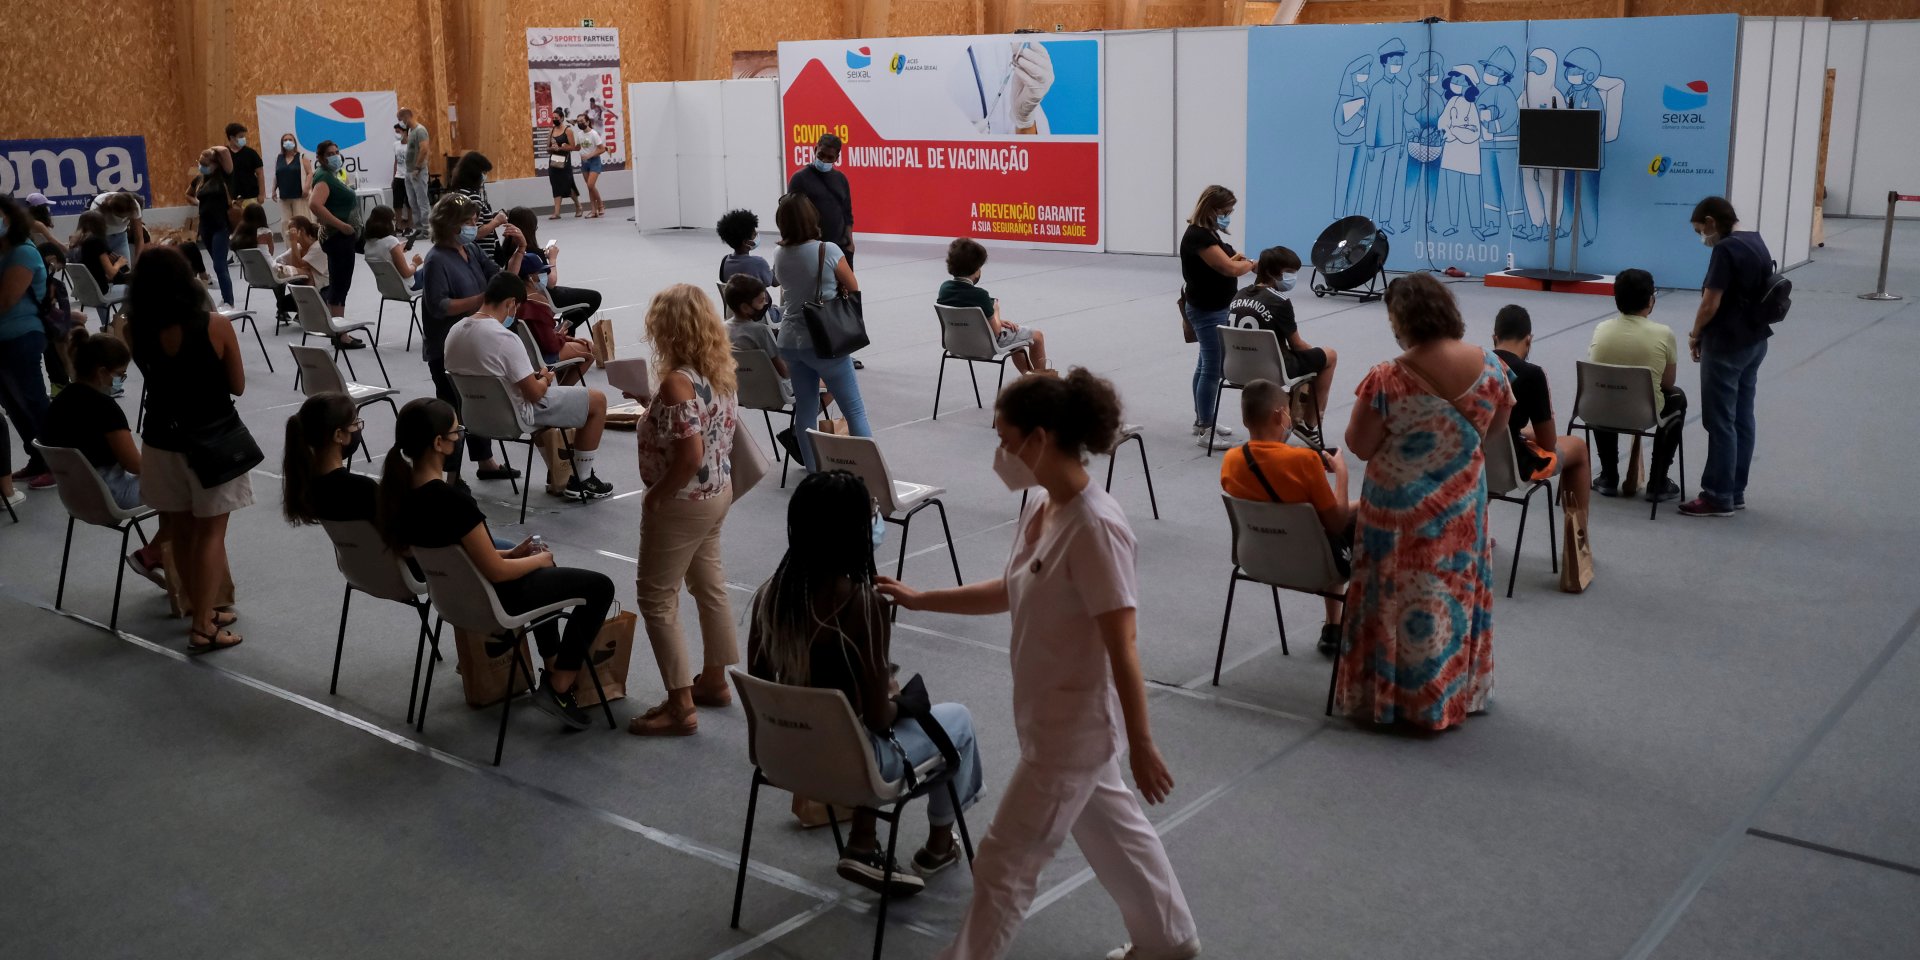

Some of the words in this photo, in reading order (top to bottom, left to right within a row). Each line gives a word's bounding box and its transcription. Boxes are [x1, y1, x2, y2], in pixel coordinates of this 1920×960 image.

[848, 146, 923, 169] MUNICIPAL
[927, 147, 945, 169] DE
[948, 145, 1029, 174] VACINAÇÃO
[971, 202, 978, 218] A
[980, 202, 1036, 223] PREVENÇÃO
[1038, 205, 1086, 223] GARANTE
[972, 220, 978, 232] A
[978, 221, 992, 233] SUA
[992, 221, 1033, 236] SEGURANÇA
[1034, 224, 1039, 235] E
[1040, 224, 1046, 236] A
[1046, 225, 1061, 236] SUA
[1062, 223, 1087, 237] SAÚDE
[1415, 240, 1499, 262] OBRIGADO
[1230, 298, 1273, 322] FERNANDES
